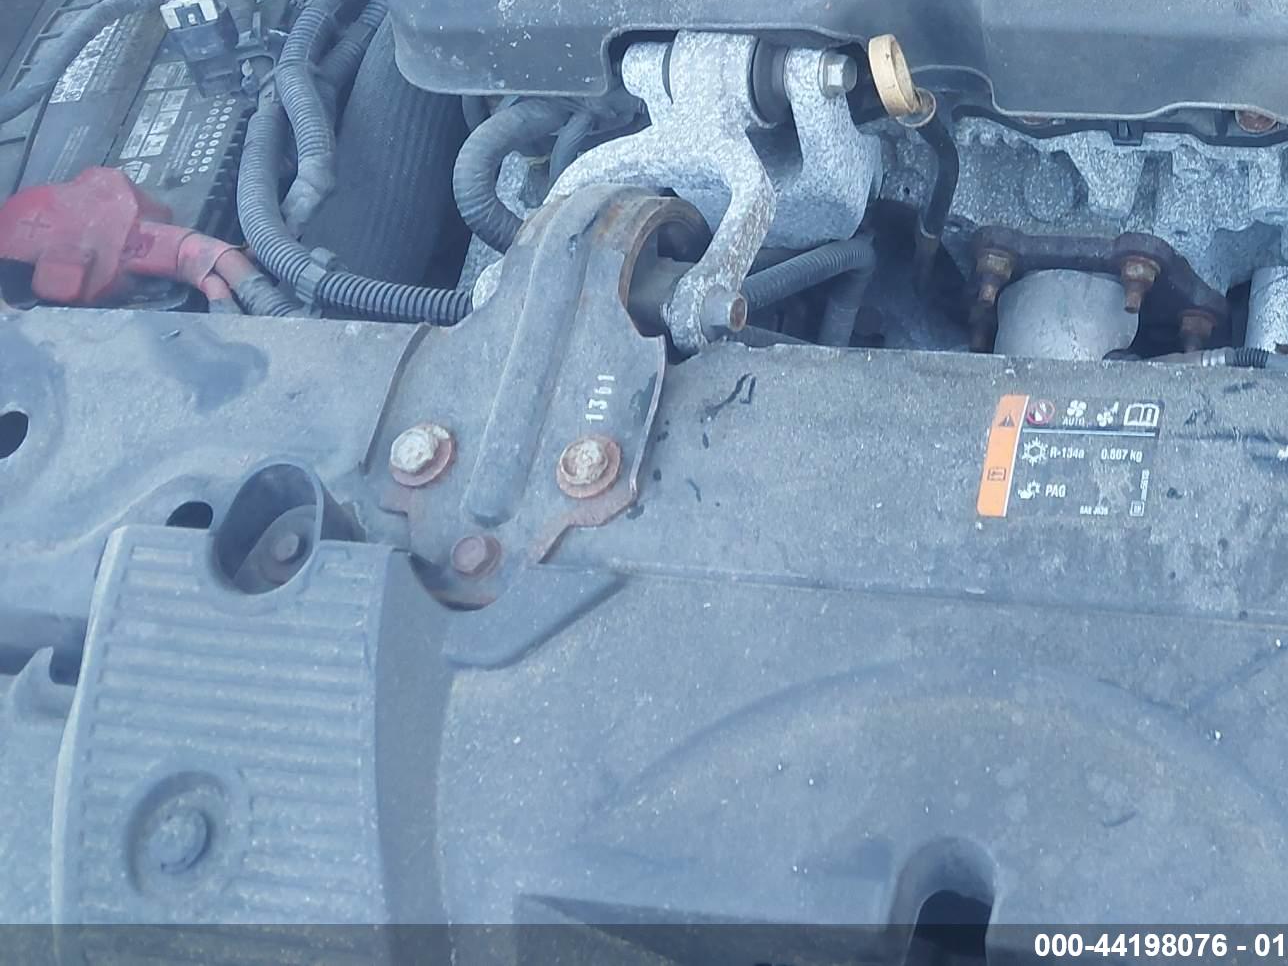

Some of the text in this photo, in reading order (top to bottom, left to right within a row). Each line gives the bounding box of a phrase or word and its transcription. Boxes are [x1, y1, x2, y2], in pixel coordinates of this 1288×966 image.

[1049, 446, 1085, 460] R-134a
[1130, 448, 1143, 463] kg
[1045, 484, 1067, 498] PAG
